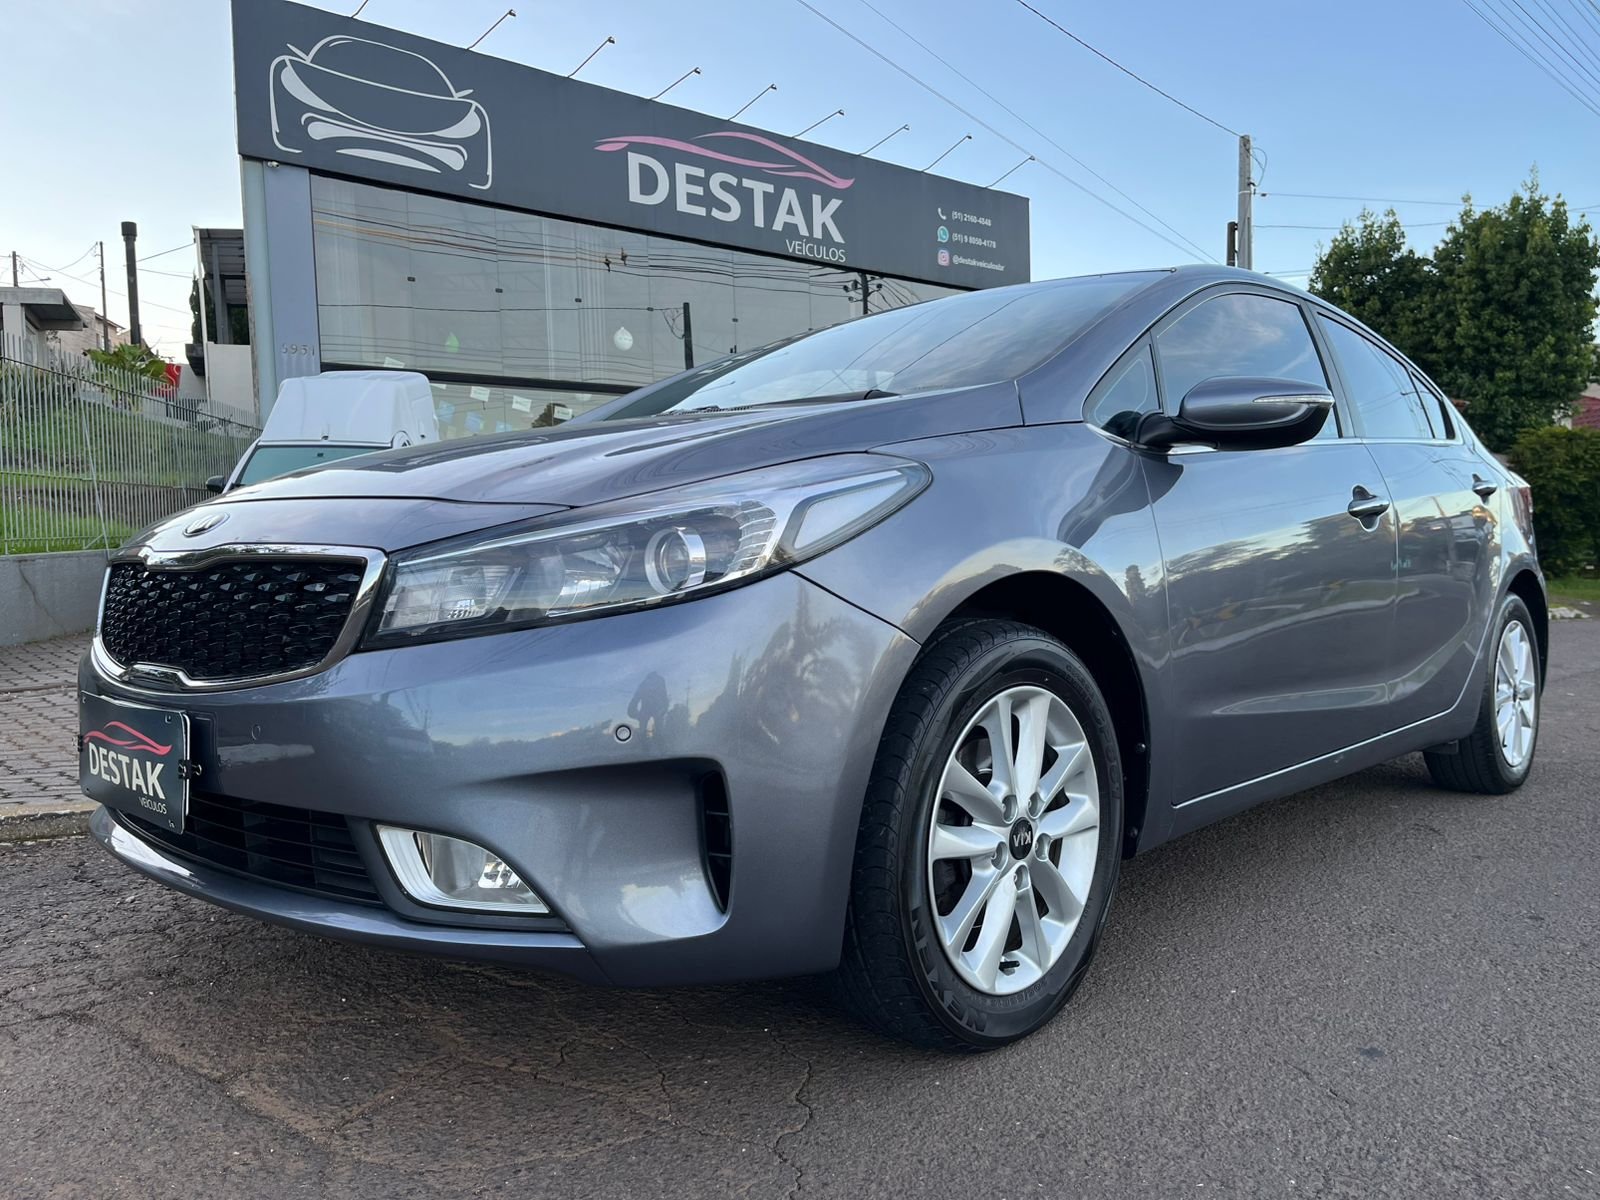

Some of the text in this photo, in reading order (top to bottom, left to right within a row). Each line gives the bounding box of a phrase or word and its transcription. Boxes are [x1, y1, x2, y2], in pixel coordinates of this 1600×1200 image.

[627, 151, 845, 244] DESTAK
[786, 239, 846, 262] VEÍCULOS
[88, 742, 166, 799] DESTAK
[138, 796, 167, 814] VEÍCULOS
